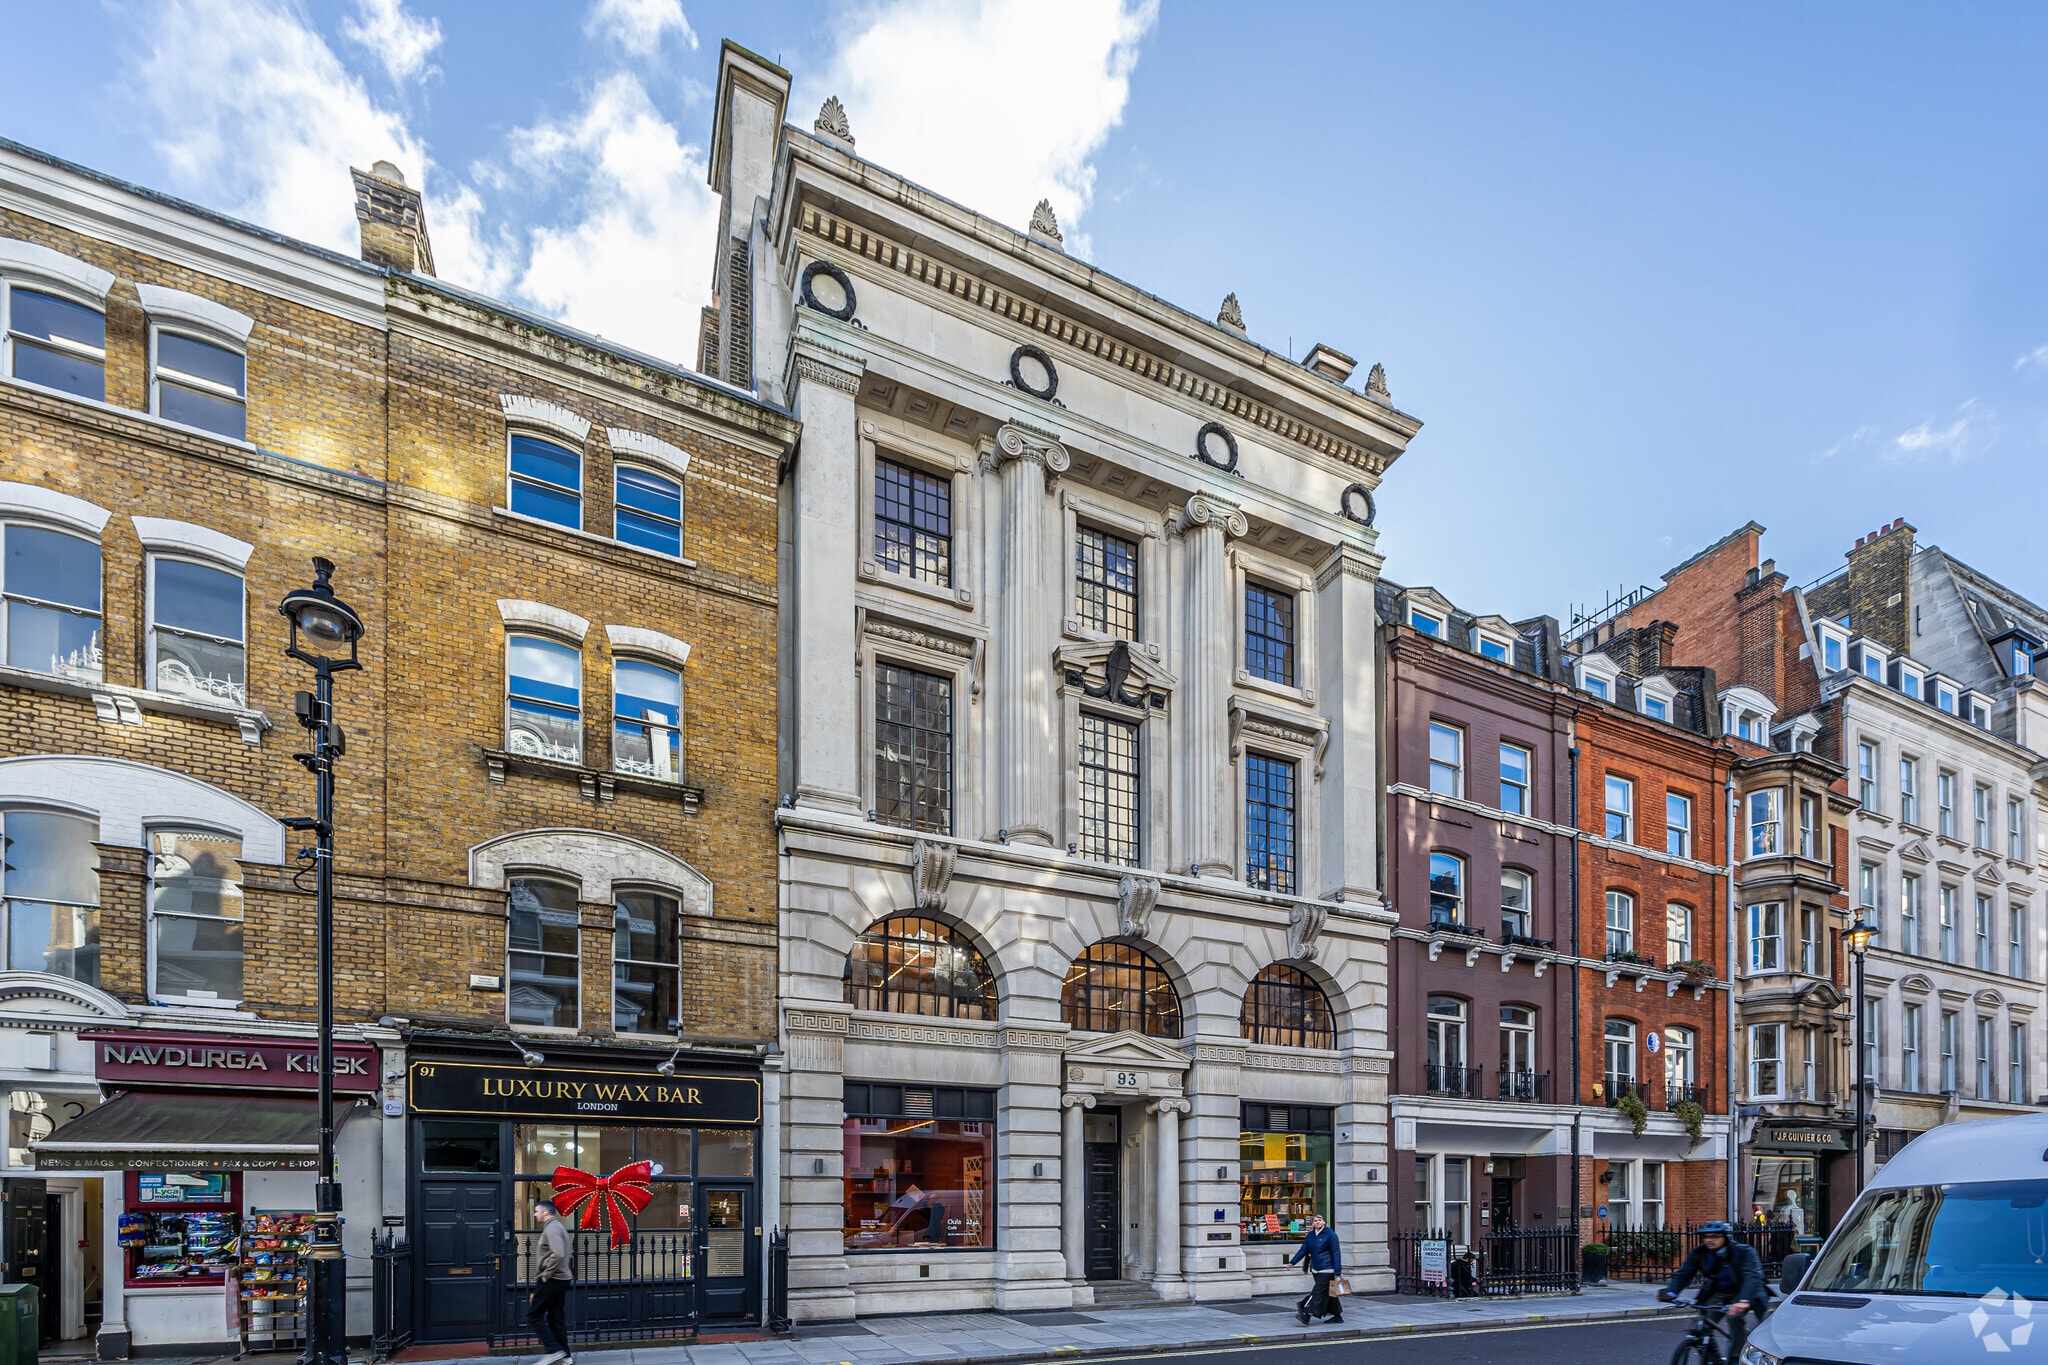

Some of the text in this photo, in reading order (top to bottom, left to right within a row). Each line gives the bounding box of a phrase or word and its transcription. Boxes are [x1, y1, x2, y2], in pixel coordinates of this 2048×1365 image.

[104, 1044, 268, 1071] NAVDURGA
[419, 1067, 436, 1077] 91
[1117, 1072, 1137, 1086] 93
[482, 1077, 703, 1105] LUXURY WAX BAR
[577, 1102, 618, 1111] LONDON
[40, 1159, 72, 1167] NEWS
[74, 1159, 82, 1167] &
[84, 1159, 115, 1167] MAGS
[128, 1159, 210, 1168] CONFECTIONERY
[222, 1160, 241, 1168] FAX
[242, 1160, 250, 1168] &
[251, 1160, 278, 1168] COPY
[289, 1160, 316, 1168] E-TOP
[154, 1188, 179, 1196] Lyca
